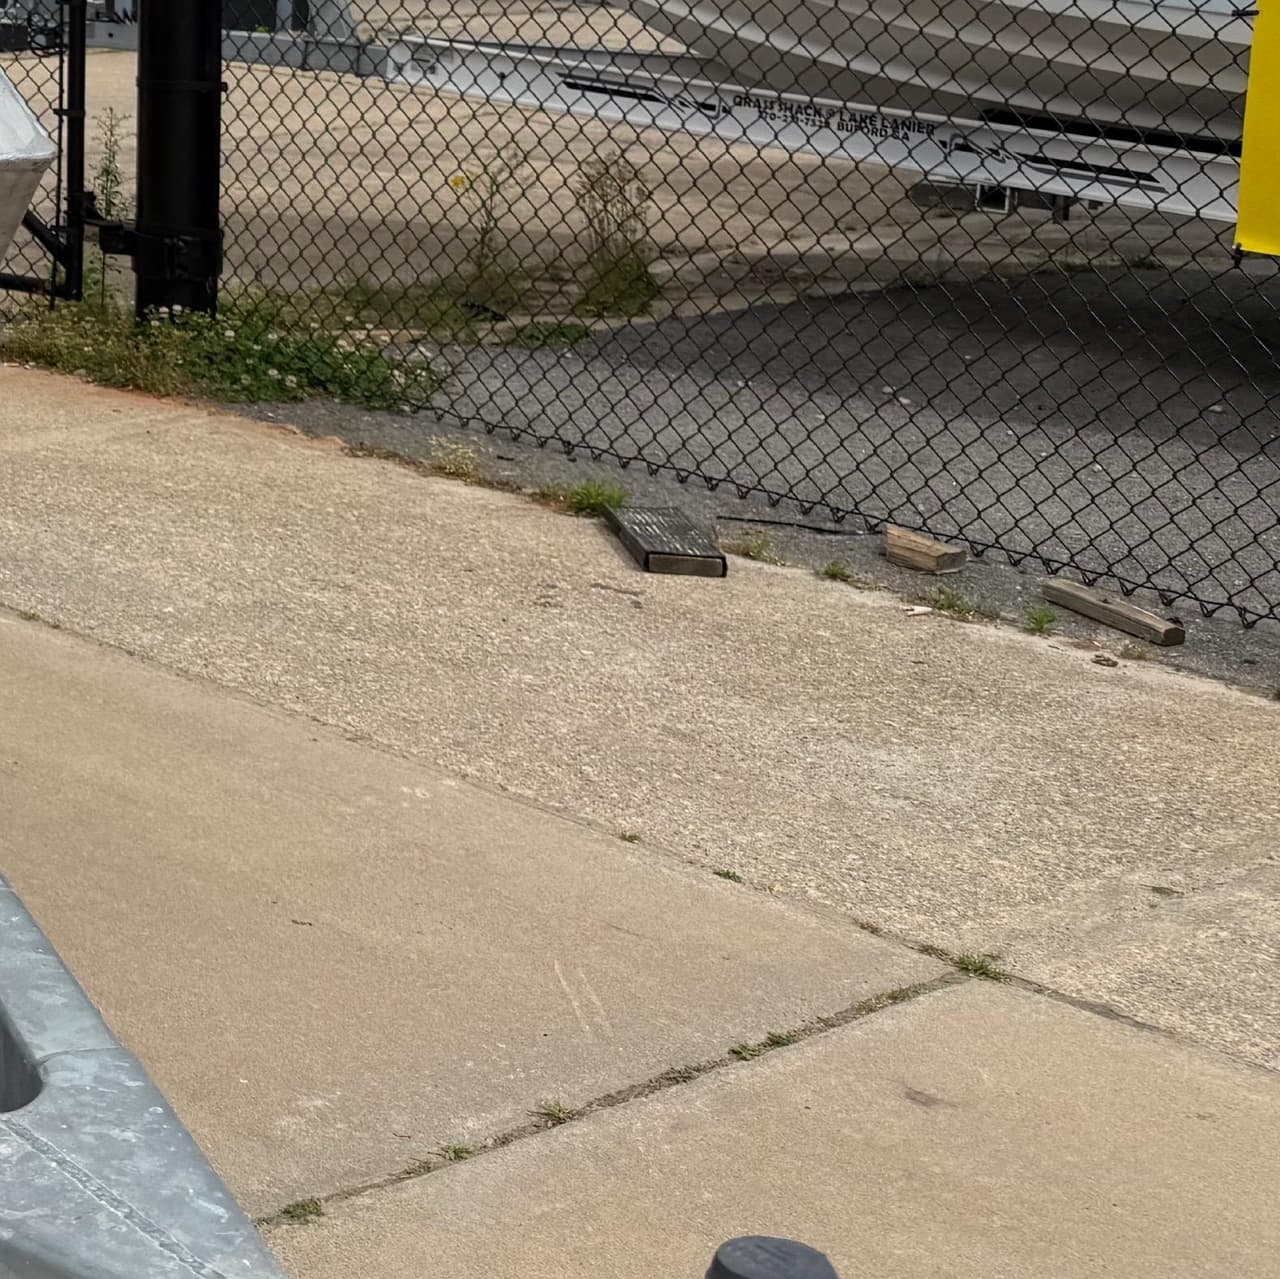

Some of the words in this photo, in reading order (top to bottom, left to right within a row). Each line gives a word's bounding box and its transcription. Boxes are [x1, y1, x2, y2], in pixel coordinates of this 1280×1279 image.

[777, 101, 822, 119] SHACK
[839, 110, 877, 127] LAKE
[881, 117, 936, 136] LANIER
[837, 121, 888, 138] BUFORD
